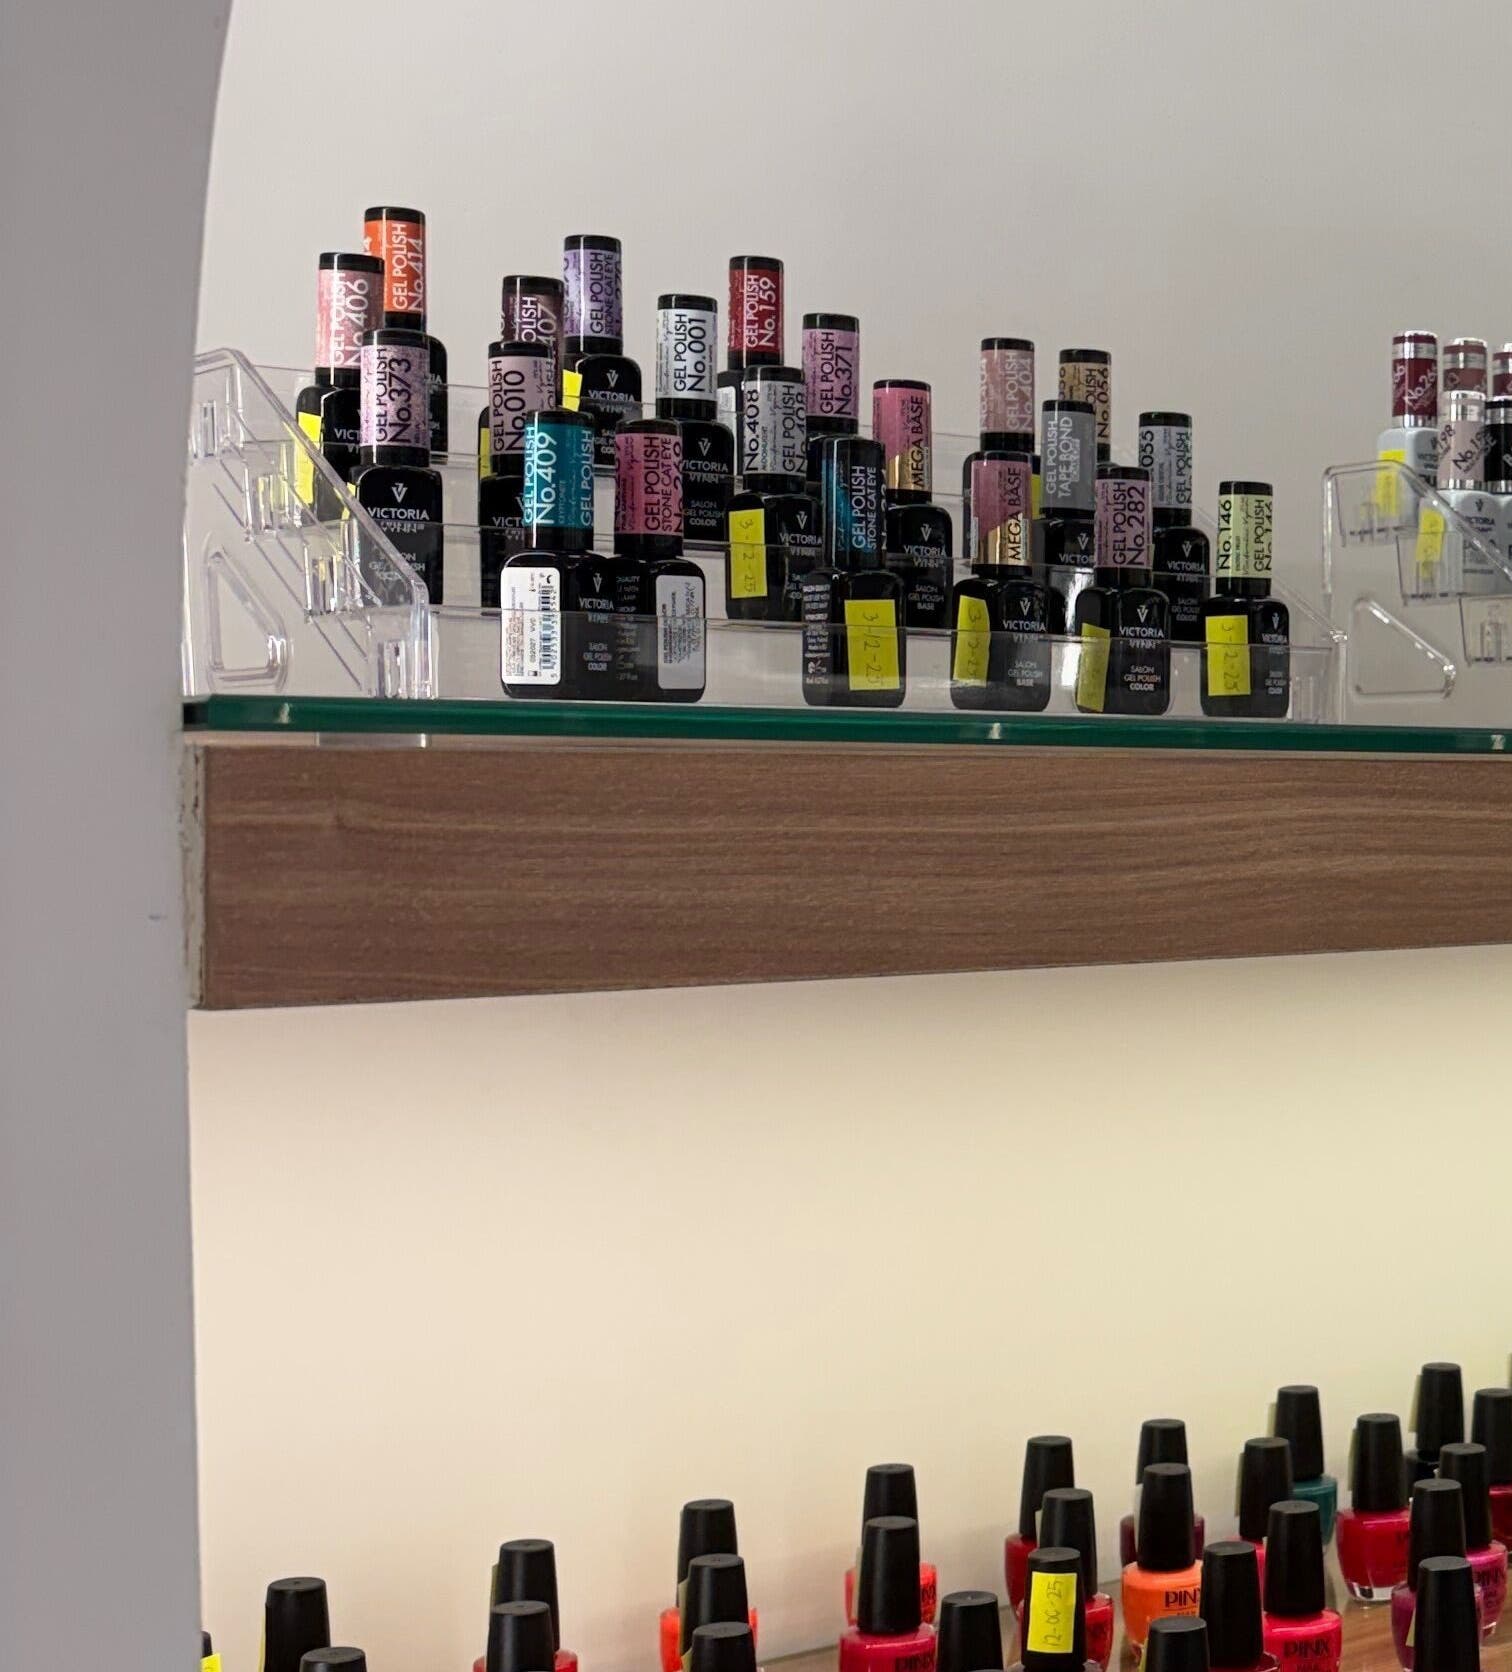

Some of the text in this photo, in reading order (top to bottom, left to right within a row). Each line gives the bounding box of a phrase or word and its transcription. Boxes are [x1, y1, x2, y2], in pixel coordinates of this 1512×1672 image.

[392, 223, 408, 310] GEL POLISH
[407, 238, 424, 312] No.414
[590, 252, 604, 334] GEL POLISH
[522, 296, 537, 342] OLISH
[604, 304, 614, 335] STONE
[745, 274, 760, 348] GEL POLISH
[758, 276, 776, 347] No.159
[674, 314, 688, 392] GEL POLISH
[688, 318, 707, 392] No.001
[820, 332, 834, 414] GEL POLISH
[834, 346, 853, 416] No.371
[1005, 352, 1020, 430] GEL POLISH
[1085, 368, 1096, 404] OLISH
[376, 348, 388, 442] GEL POLISH
[388, 357, 412, 444] No.373
[492, 360, 504, 451] GEL POLISH
[745, 388, 760, 472] No.408
[782, 384, 795, 472] GEL POLISH
[523, 426, 537, 522] GEL POLISH
[536, 432, 557, 524] No.409
[580, 430, 592, 526] GEL POLISH
[911, 396, 924, 488] MEGA BASE
[1046, 420, 1058, 494] GEL POLISH
[1058, 416, 1073, 499] TAPE BOND
[1176, 432, 1186, 504] GEL POLISH
[367, 507, 430, 520] VICTORIA
[644, 436, 660, 531] GEL POLISH
[662, 438, 672, 532] STONE CAT EYE
[852, 466, 866, 549] GEL POLISH
[867, 467, 877, 550] STONE CAT EYE
[1008, 466, 1022, 561] MEGA BASE
[1112, 481, 1126, 564] GEL POLISH
[1128, 486, 1146, 566] No.282
[1218, 500, 1232, 570] No.146
[1254, 500, 1264, 572] GEL POLISH
[1003, 620, 1046, 632] VICTORIA
[1119, 626, 1164, 638] VICTORIA
[1165, 1588, 1200, 1608] PIN
[1284, 1639, 1330, 1658] PINX
